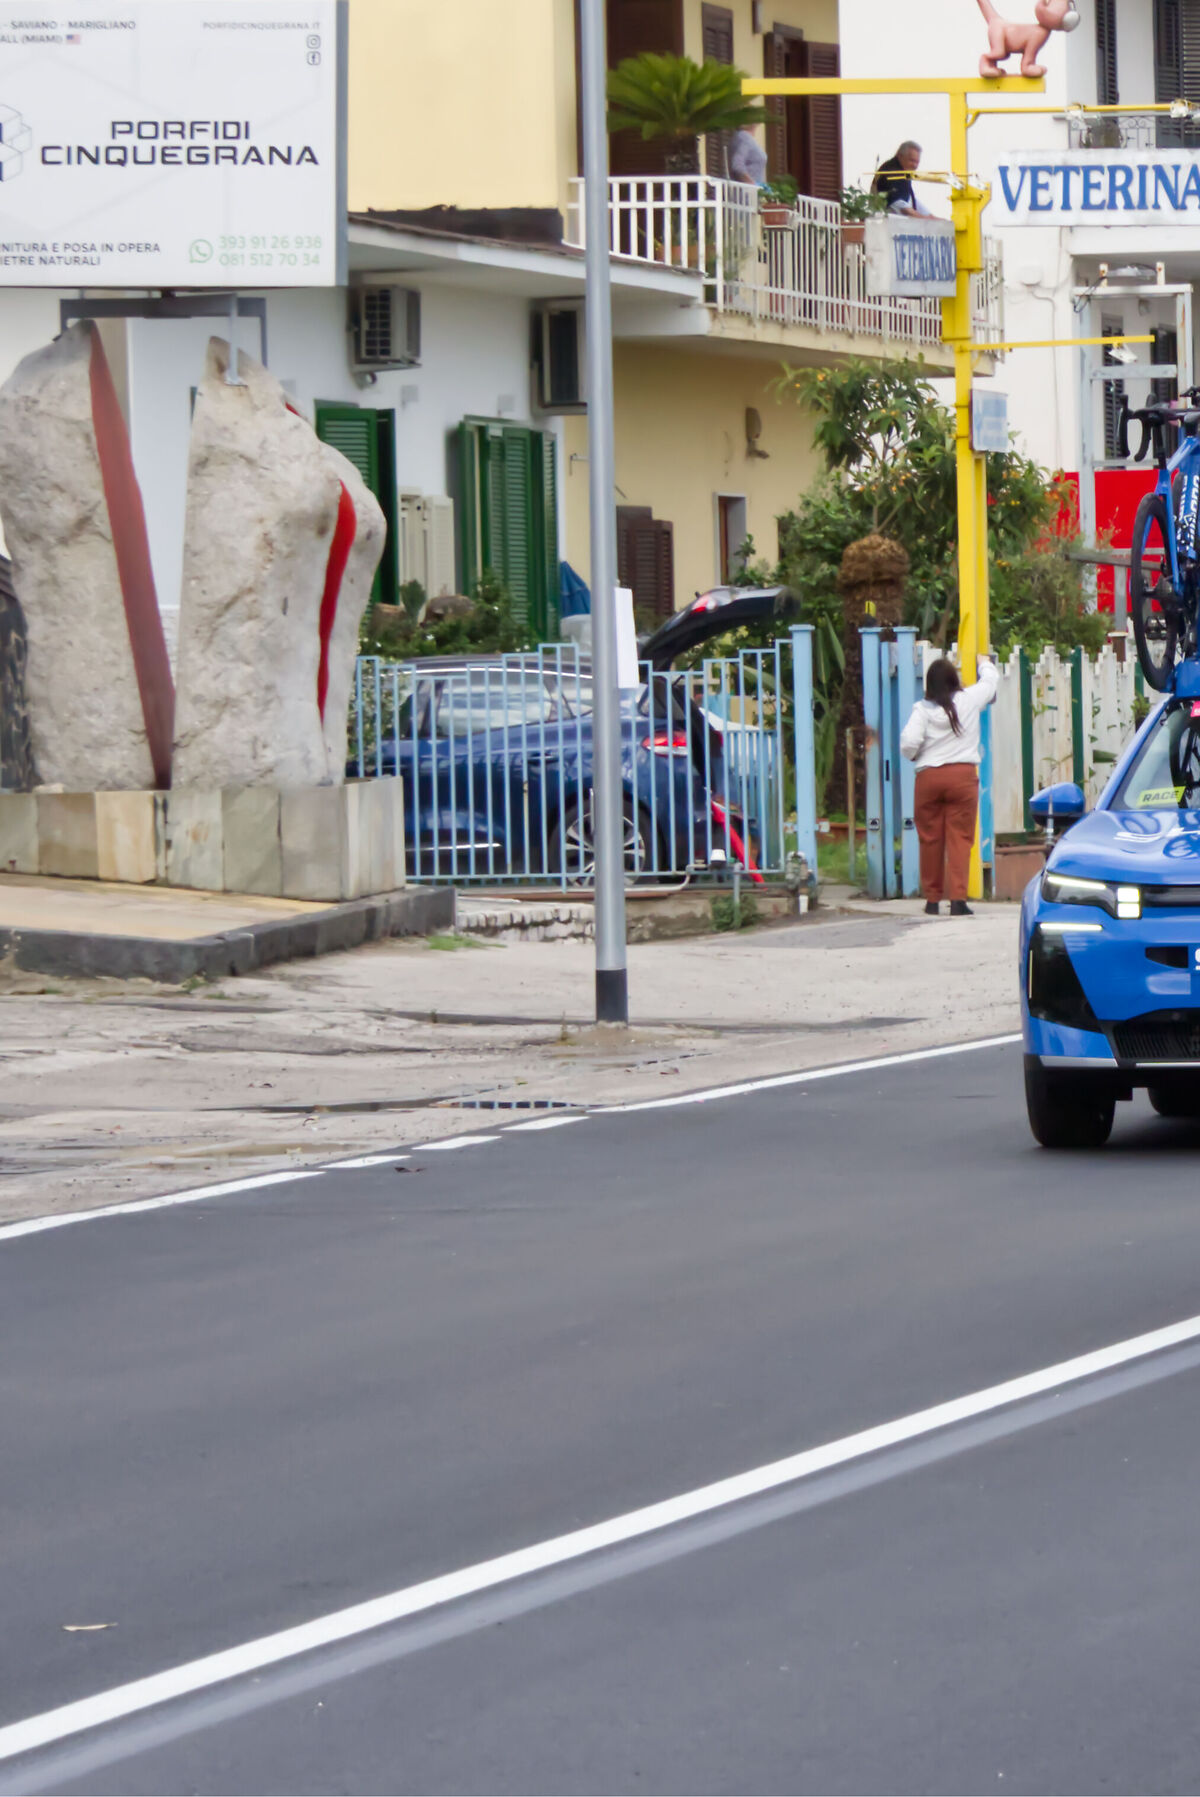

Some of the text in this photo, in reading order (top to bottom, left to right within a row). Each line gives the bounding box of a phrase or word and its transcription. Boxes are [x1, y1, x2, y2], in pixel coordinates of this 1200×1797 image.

[10, 20, 137, 30] SAVIANO MARIGLIANO
[111, 121, 250, 140] PORFIDI
[41, 146, 319, 166] CINQUEGRANA
[52, 242, 59, 253] E
[64, 242, 98, 253] POSA
[101, 242, 114, 253] IN
[118, 242, 161, 253] OPERA
[40, 255, 101, 266] NATURALI
[1142, 790, 1180, 802] RACE
